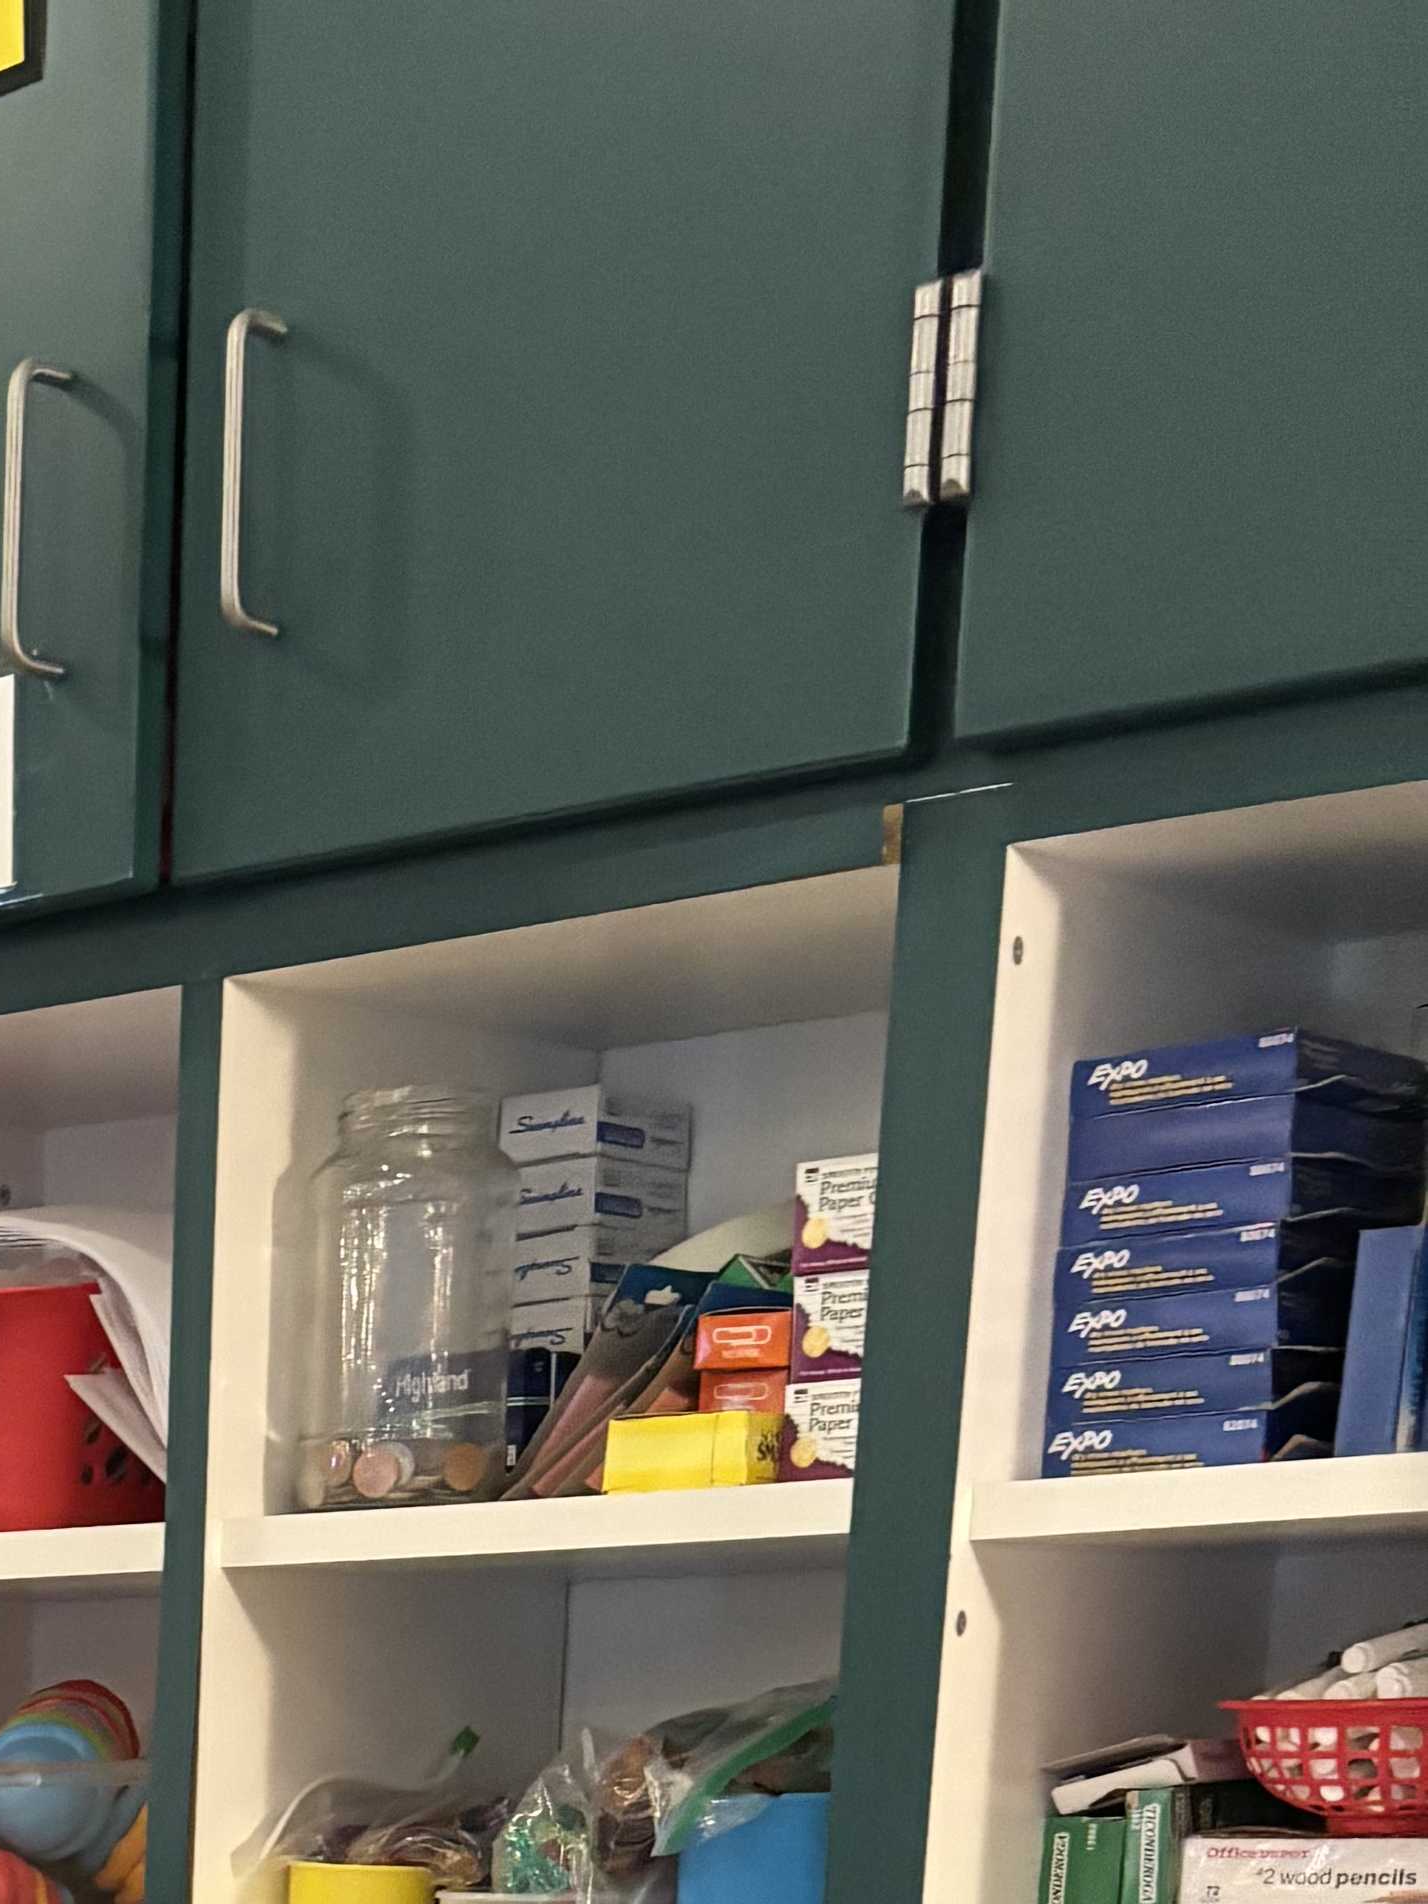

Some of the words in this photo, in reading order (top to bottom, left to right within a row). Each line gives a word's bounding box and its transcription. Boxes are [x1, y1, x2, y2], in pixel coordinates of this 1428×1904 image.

[1087, 1059, 1149, 1090] EXPO
[819, 1196, 864, 1212] Paper
[1079, 1184, 1140, 1216] EXPO
[1070, 1249, 1131, 1278] EXPO
[821, 1306, 864, 1323] Paper
[1068, 1308, 1127, 1338] EXPO
[1062, 1369, 1121, 1399] EXPO
[809, 1417, 853, 1433] Paper
[1048, 1429, 1112, 1460] EXPO
[1280, 1868, 1332, 1886] wood
[1335, 1868, 1418, 1888] pencils
